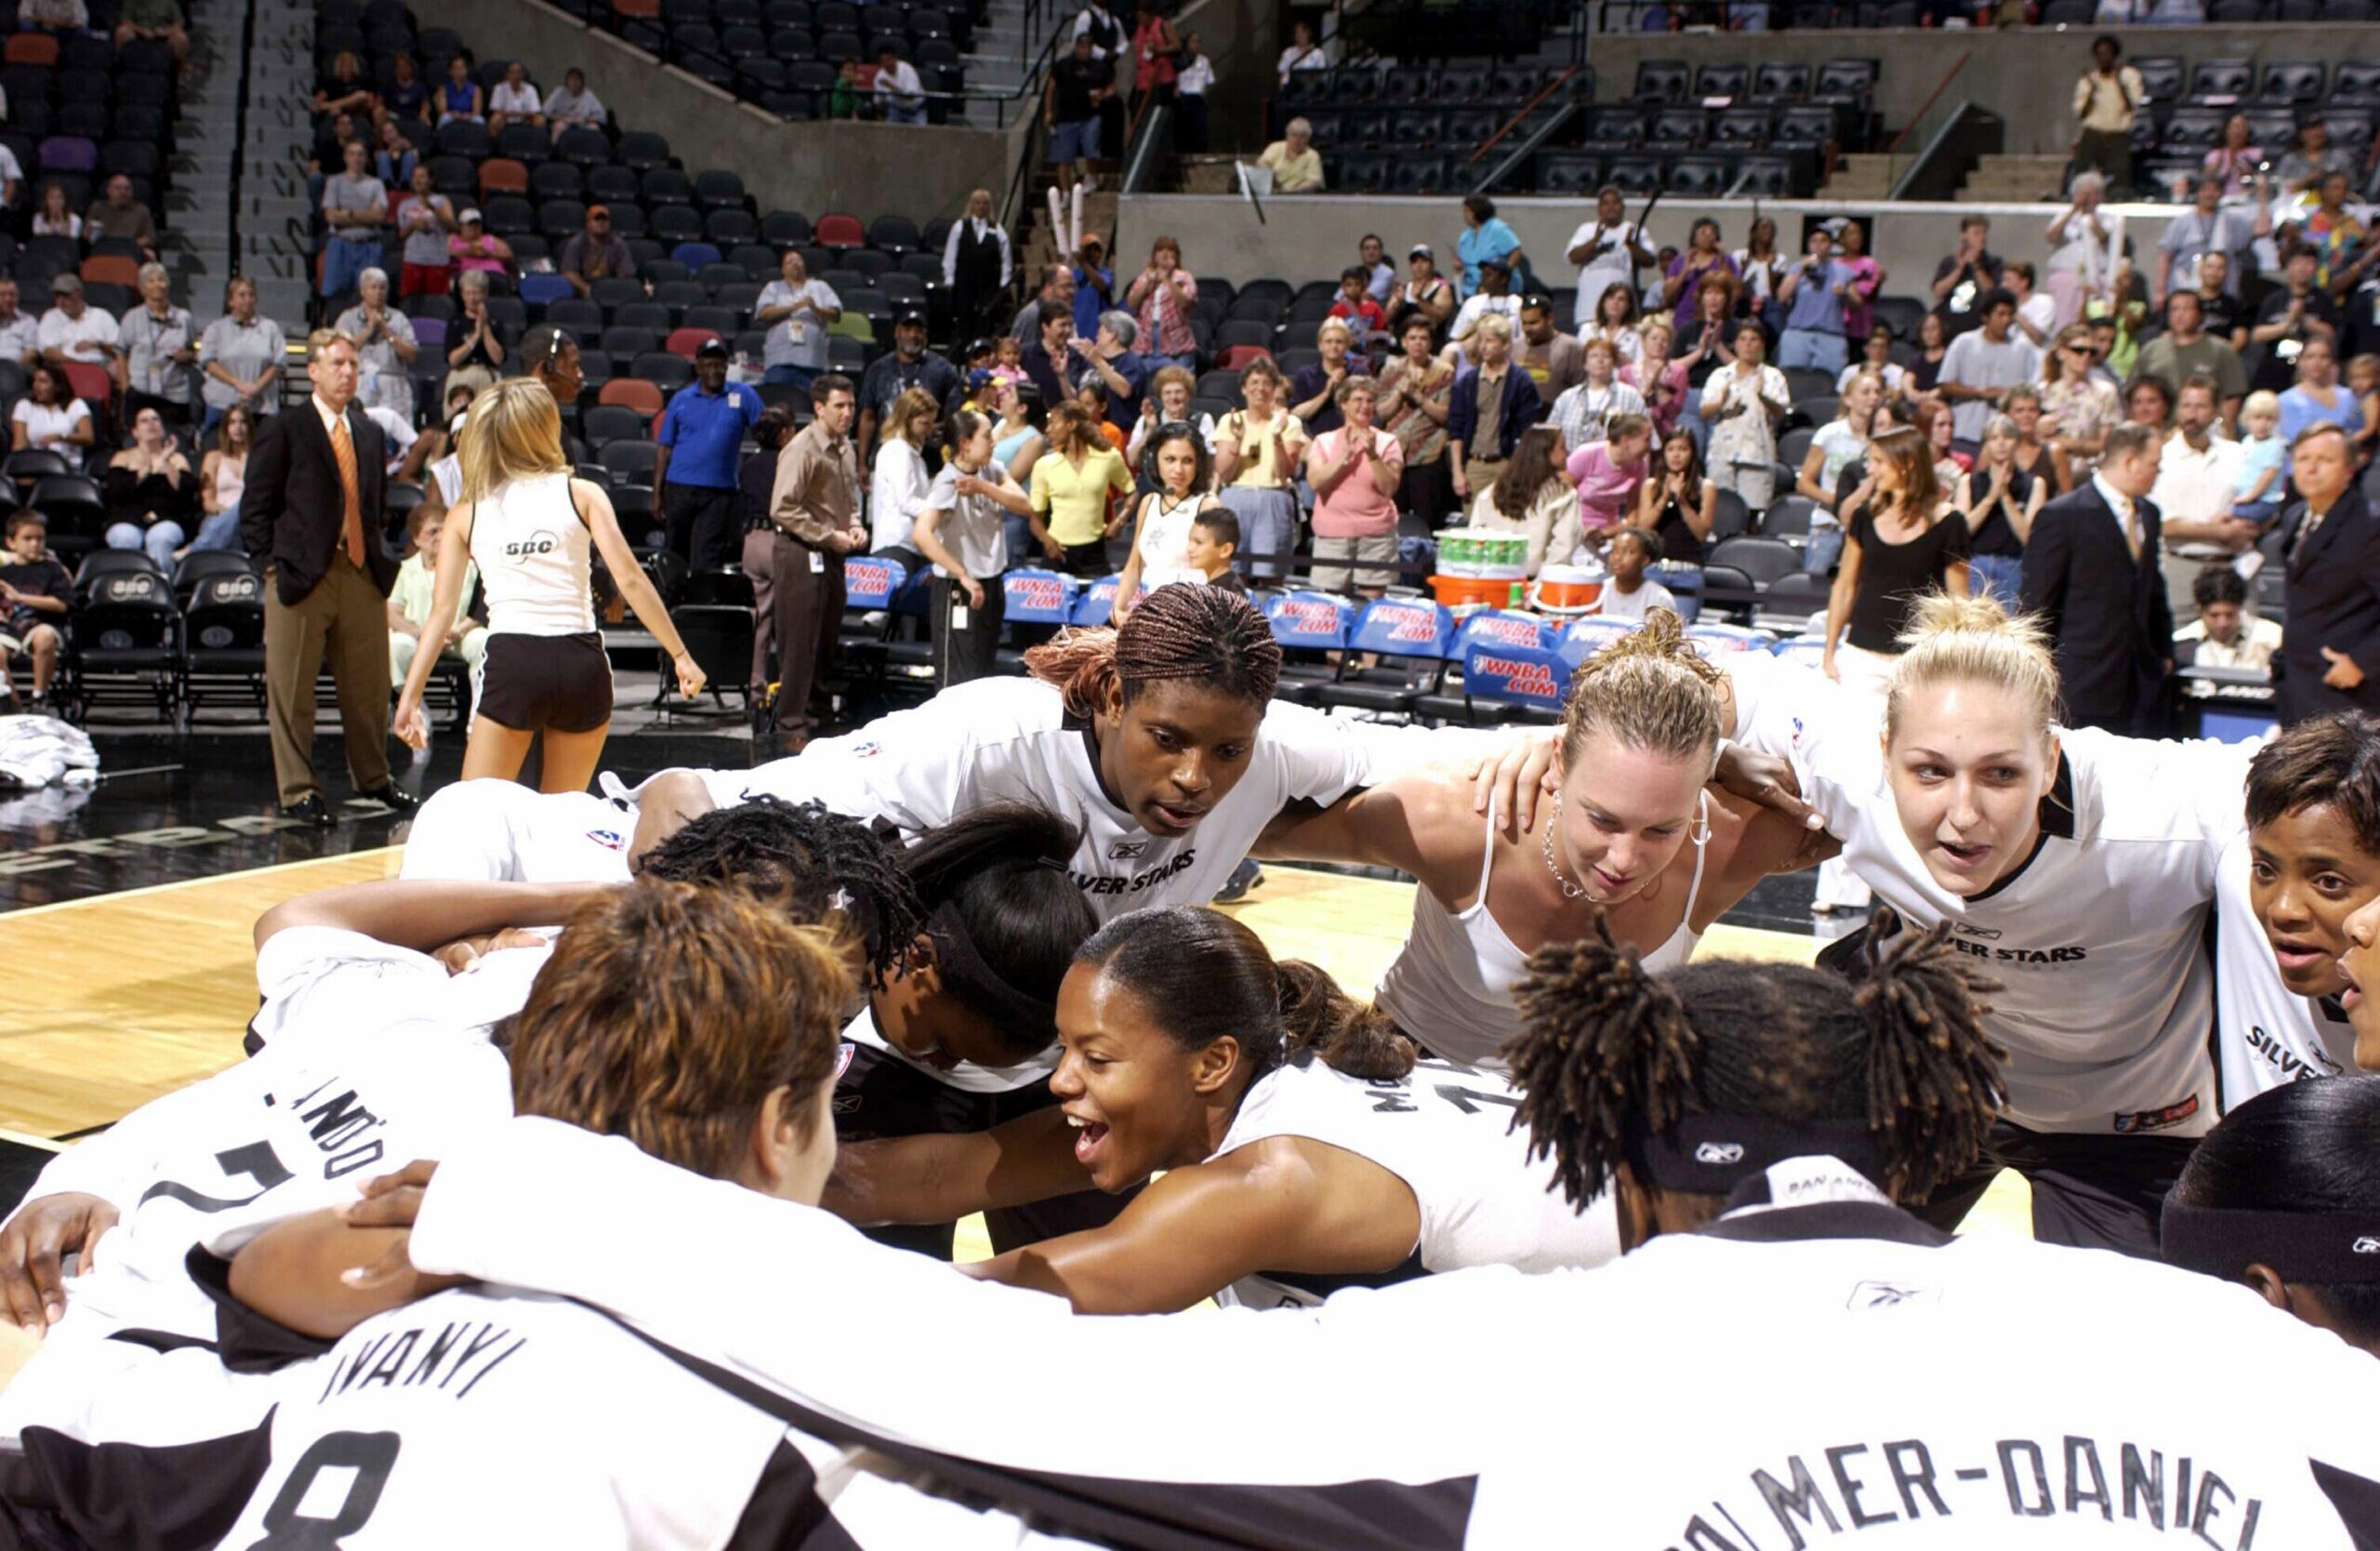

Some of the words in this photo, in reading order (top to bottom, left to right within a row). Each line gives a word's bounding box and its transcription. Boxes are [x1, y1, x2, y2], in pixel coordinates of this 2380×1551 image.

[506, 540, 552, 556] SBC
[1012, 577, 1063, 594] WNBA
[1484, 616, 1540, 638] WNBA
[1486, 656, 1551, 681] WNBA
[1129, 848, 1196, 893] STARS
[1996, 947, 2086, 963] STARS
[318, 1321, 527, 1405] IVANYI
[244, 1430, 402, 1551] 8
